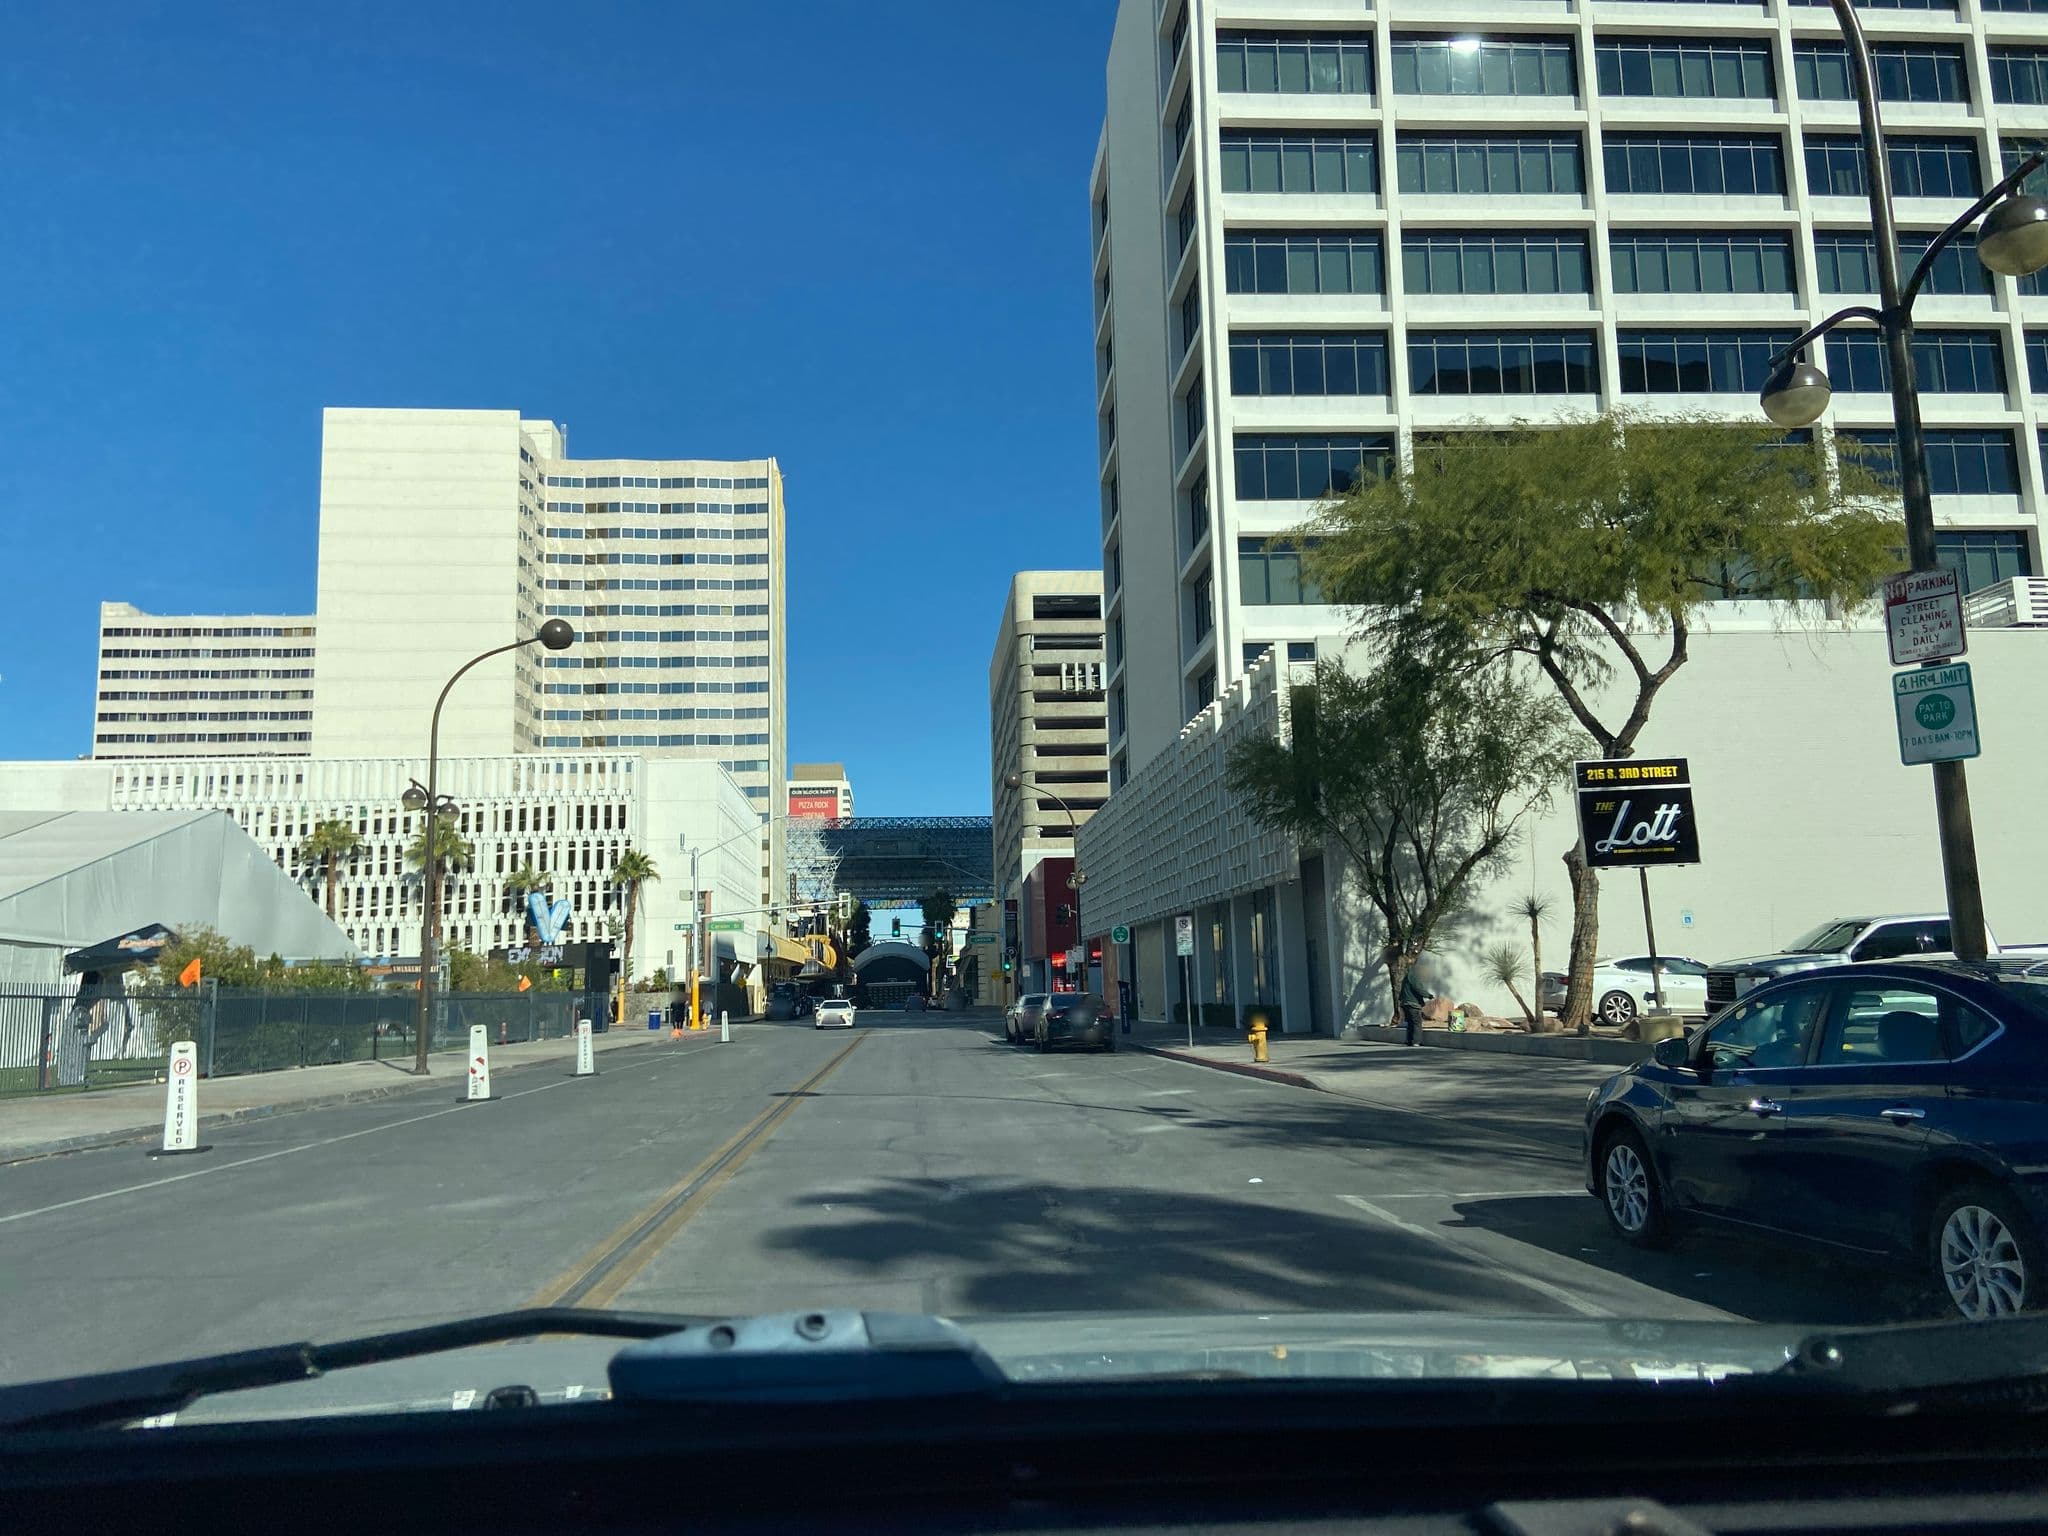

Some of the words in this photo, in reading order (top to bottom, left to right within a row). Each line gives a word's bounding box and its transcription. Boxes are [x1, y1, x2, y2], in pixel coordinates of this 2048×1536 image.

[1908, 574, 1954, 593] PARKING
[1905, 600, 1940, 614] STREET
[1901, 610, 1948, 625] CLEANING
[1938, 620, 1952, 630] AM
[1913, 633, 1940, 646] DAILY
[1899, 677, 1907, 690] 4
[1911, 675, 1927, 689] HR
[1934, 668, 1965, 685] LIMIT
[1919, 703, 1935, 713] PAY
[1937, 701, 1950, 710] TO
[1923, 712, 1948, 722] PARK
[1904, 738, 1908, 748] 7
[1911, 734, 1934, 746] DAYS
[1587, 769, 1605, 780] 215
[1619, 767, 1640, 779] 3RD
[1641, 766, 1678, 778] STREET
[798, 801, 813, 809] PIZZA
[814, 801, 829, 809] ROCK
[1595, 801, 1616, 811] THE
[1595, 800, 1682, 852] Lott
[175, 1078, 185, 1144] RESERVED
